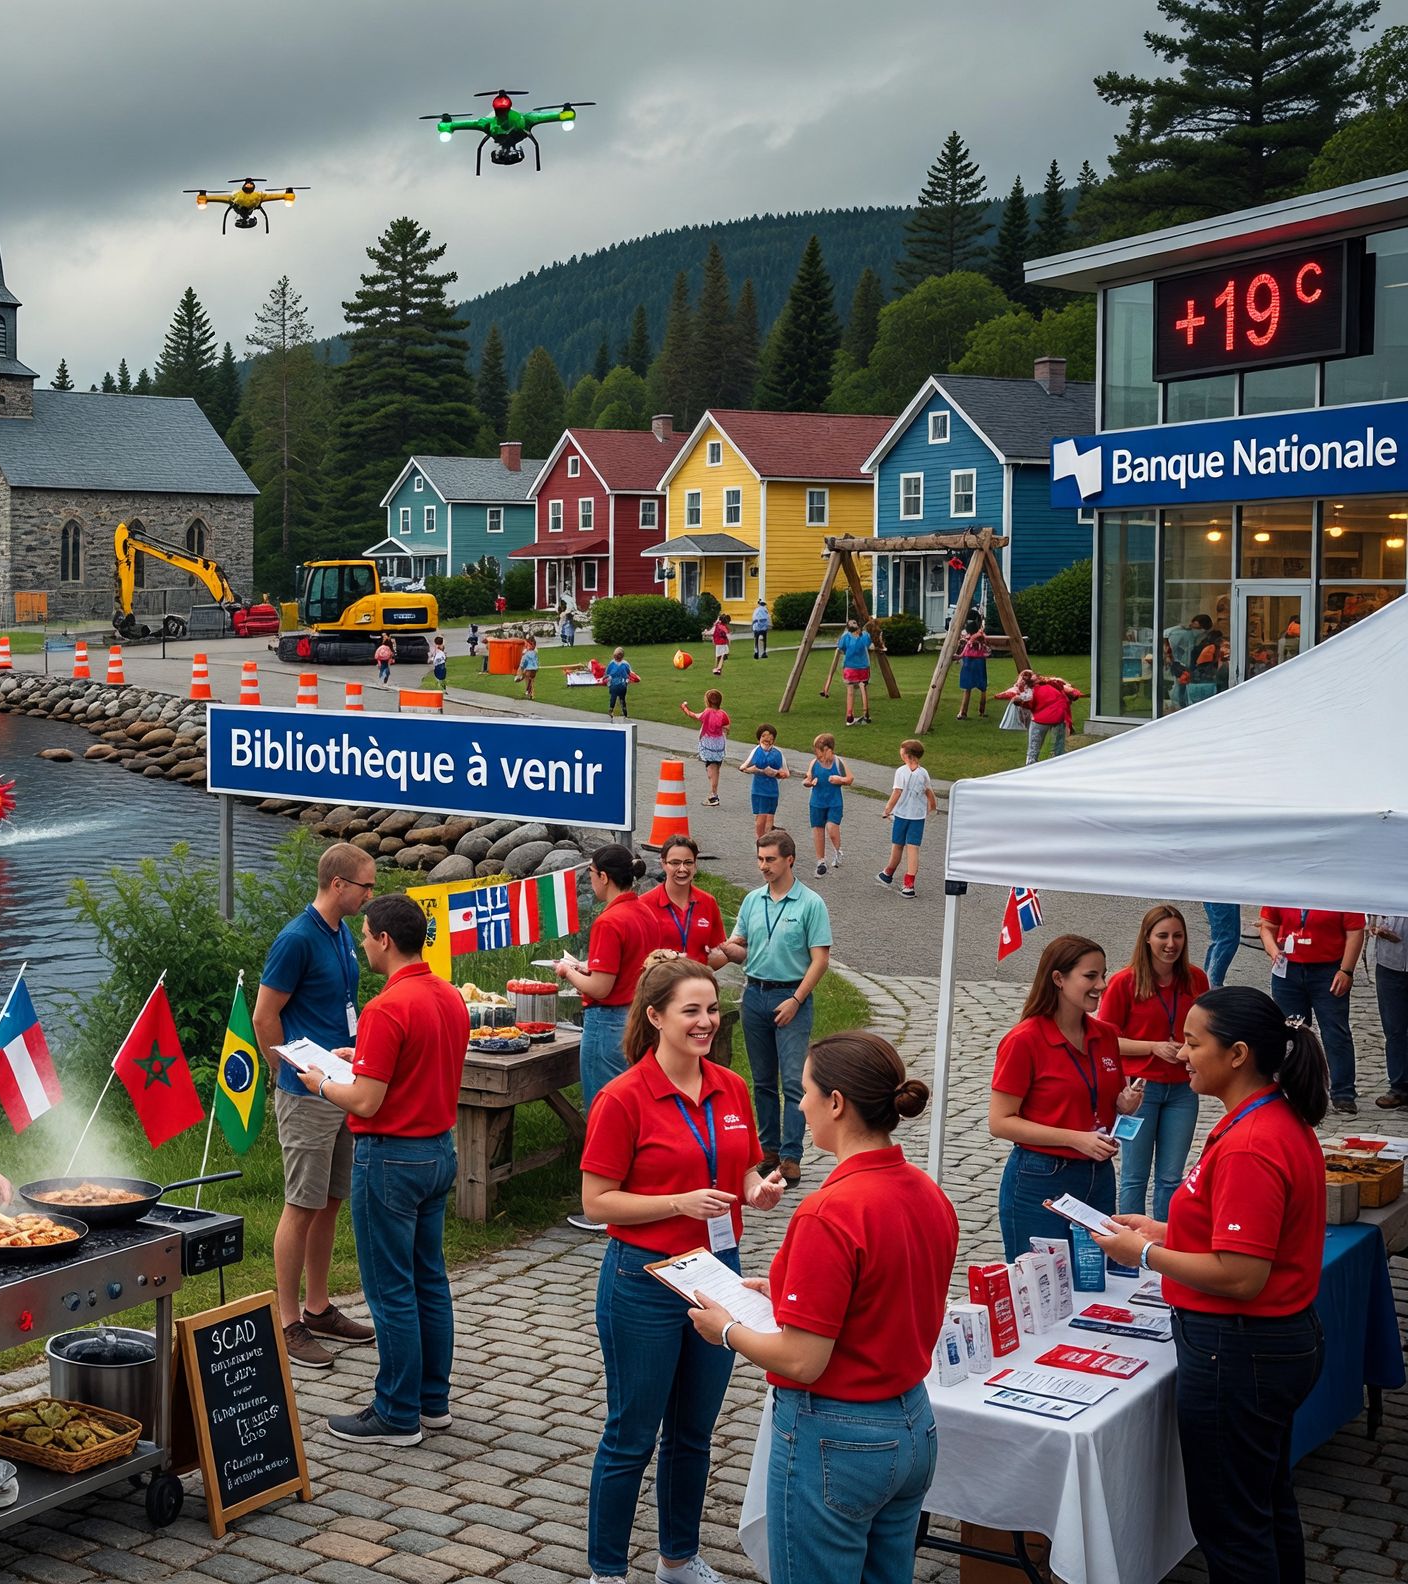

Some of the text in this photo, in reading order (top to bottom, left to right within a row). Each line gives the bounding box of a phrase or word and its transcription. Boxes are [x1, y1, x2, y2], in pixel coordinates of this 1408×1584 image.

[1111, 427, 1397, 489] Banque Nationale
[230, 728, 603, 795] Bibliothèque à venir
